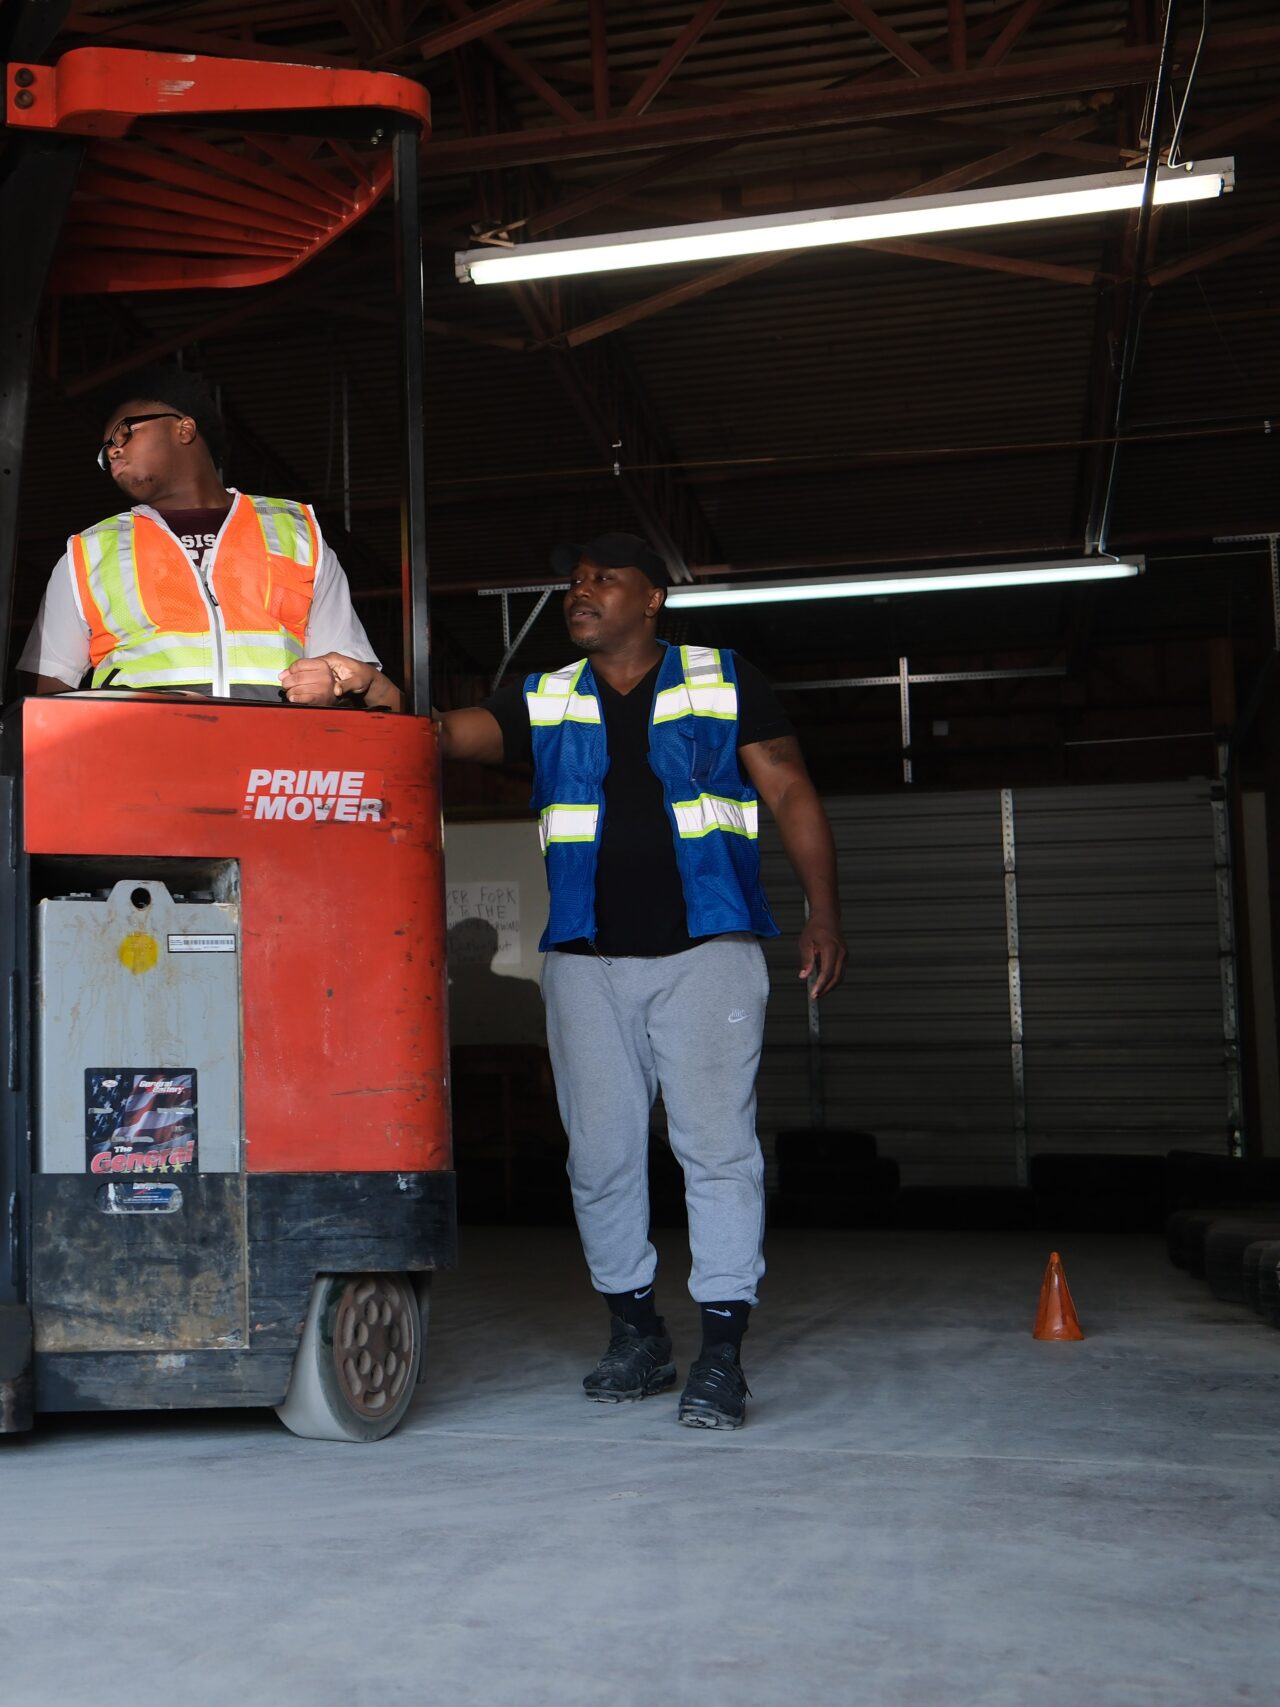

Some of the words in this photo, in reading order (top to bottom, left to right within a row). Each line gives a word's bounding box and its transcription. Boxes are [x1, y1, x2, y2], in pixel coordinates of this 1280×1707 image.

[246, 768, 365, 796] PRIME
[254, 795, 384, 822] MOVER
[91, 1140, 195, 1174] General
